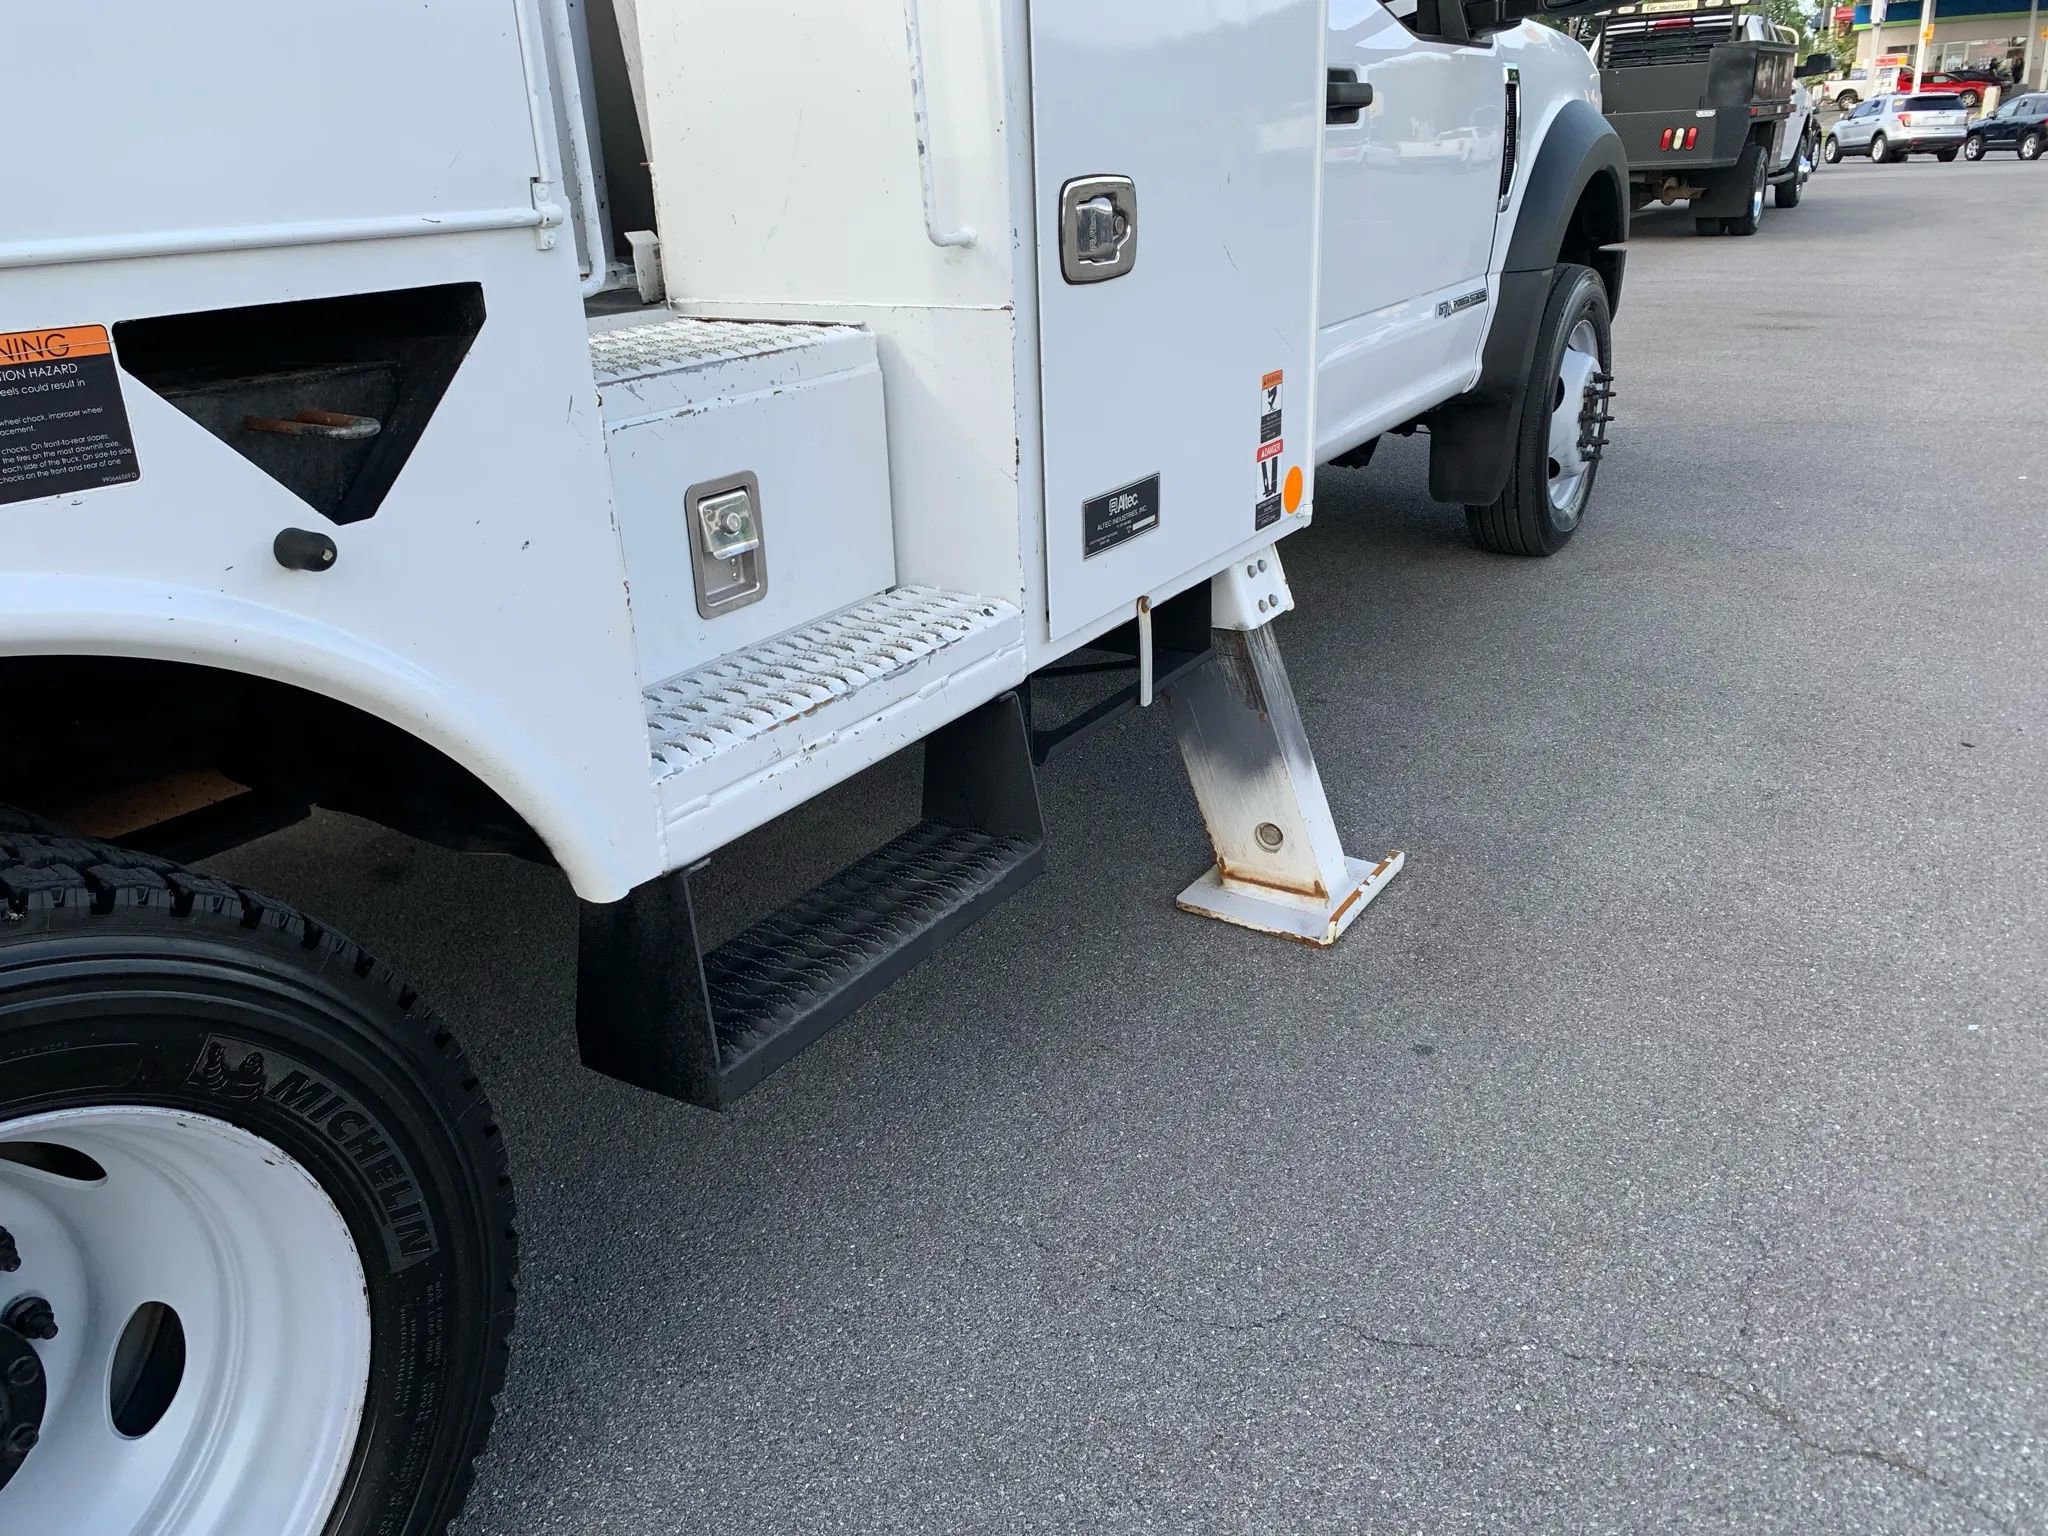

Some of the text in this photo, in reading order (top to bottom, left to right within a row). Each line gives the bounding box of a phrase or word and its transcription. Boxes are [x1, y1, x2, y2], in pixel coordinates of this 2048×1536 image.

[28, 363, 78, 378] HAZARD
[21, 382, 49, 394] could
[51, 379, 75, 390] result
[76, 378, 86, 387] in
[48, 409, 81, 420] improper
[81, 406, 103, 415] wheel
[2, 457, 15, 465] the
[16, 454, 31, 462] tires
[43, 450, 56, 458] the
[57, 446, 74, 455] most
[1261, 443, 1280, 456] DANGER
[2, 464, 23, 473] each
[23, 462, 38, 471] side
[39, 460, 47, 468] of
[82, 453, 93, 461] On
[118, 447, 132, 455] side
[25, 472, 36, 480] on
[36, 470, 49, 478] the
[50, 466, 67, 475] front
[67, 464, 83, 472] and
[83, 462, 97, 470] rear
[98, 459, 106, 467] of
[107, 458, 121, 466] one
[1118, 494, 1138, 513] Altec
[1097, 520, 1111, 531] ALTEC
[265, 1069, 433, 1257] MICHELIN
